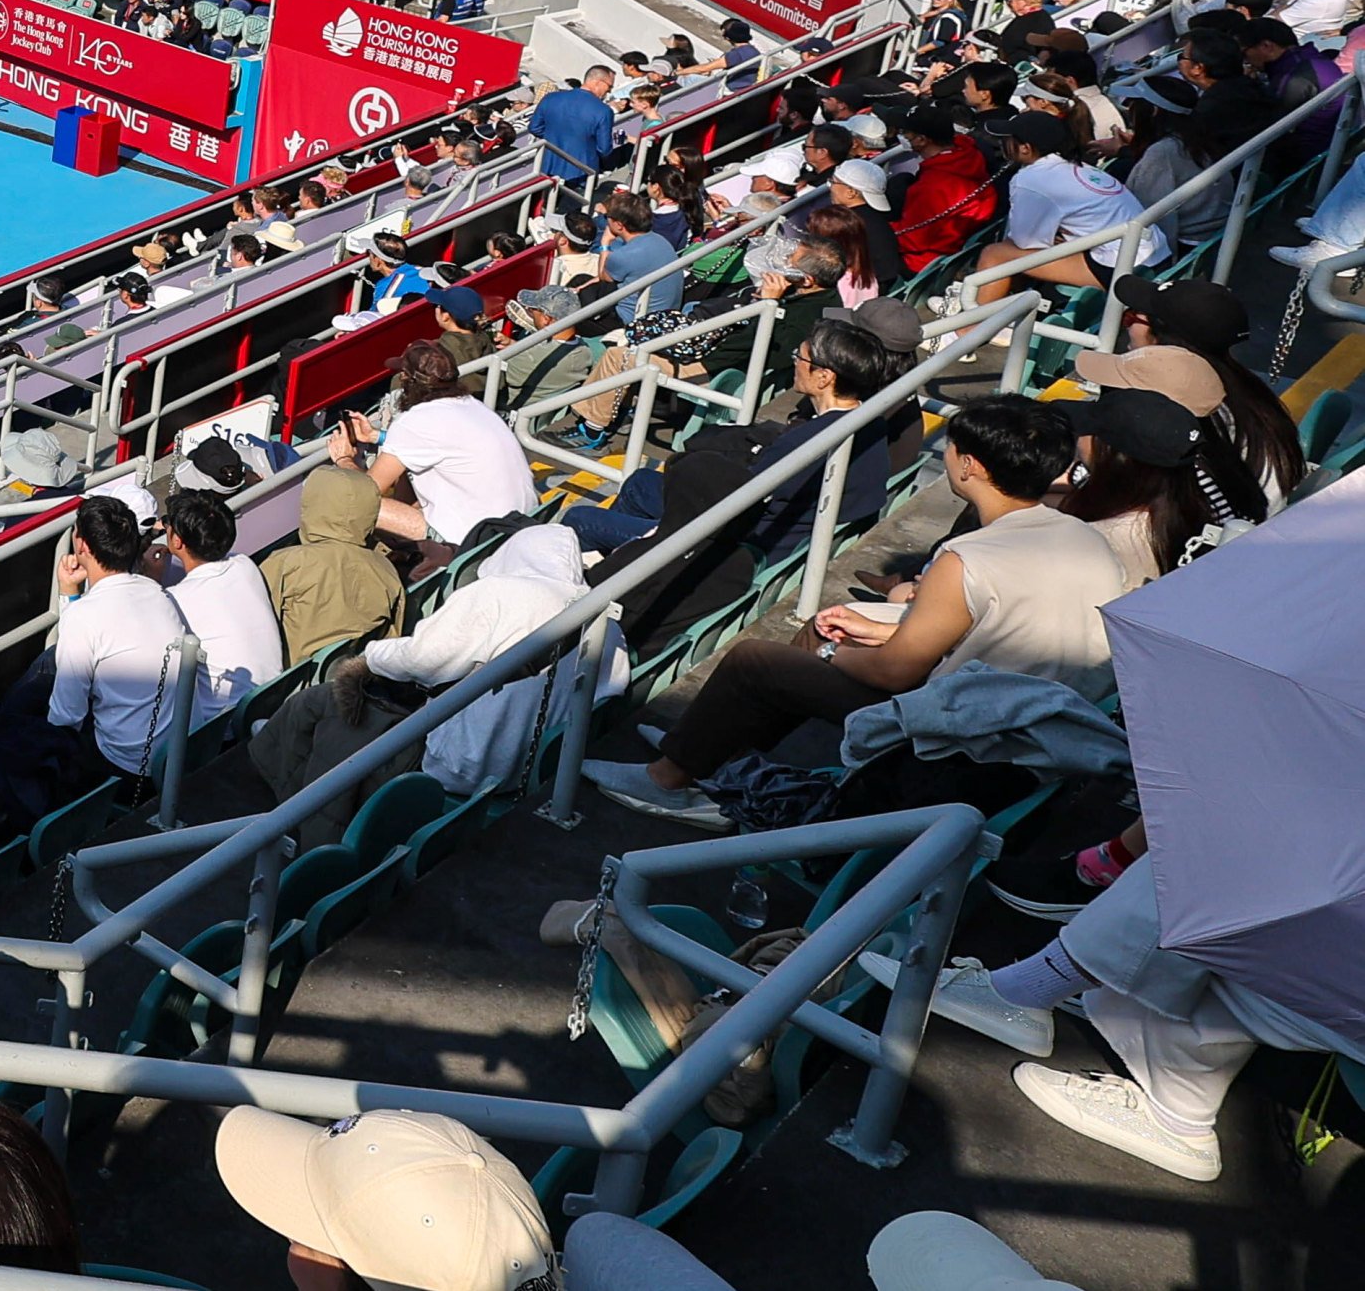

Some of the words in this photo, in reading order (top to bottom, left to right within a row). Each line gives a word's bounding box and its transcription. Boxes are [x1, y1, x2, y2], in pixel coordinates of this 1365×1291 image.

[13, 7, 67, 34] 香港賽馬會
[13, 20, 27, 34] The
[27, 24, 45, 43] Hong
[45, 30, 64, 49] Kong
[368, 17, 414, 42] HONG
[414, 30, 459, 55] KONG
[11, 34, 36, 53] Jockey
[35, 42, 52, 57] Club
[367, 32, 414, 58] TOURISM
[414, 47, 456, 69] BOARD
[363, 46, 454, 85] 香港旅遊發展局
[168, 121, 221, 164] 香港
